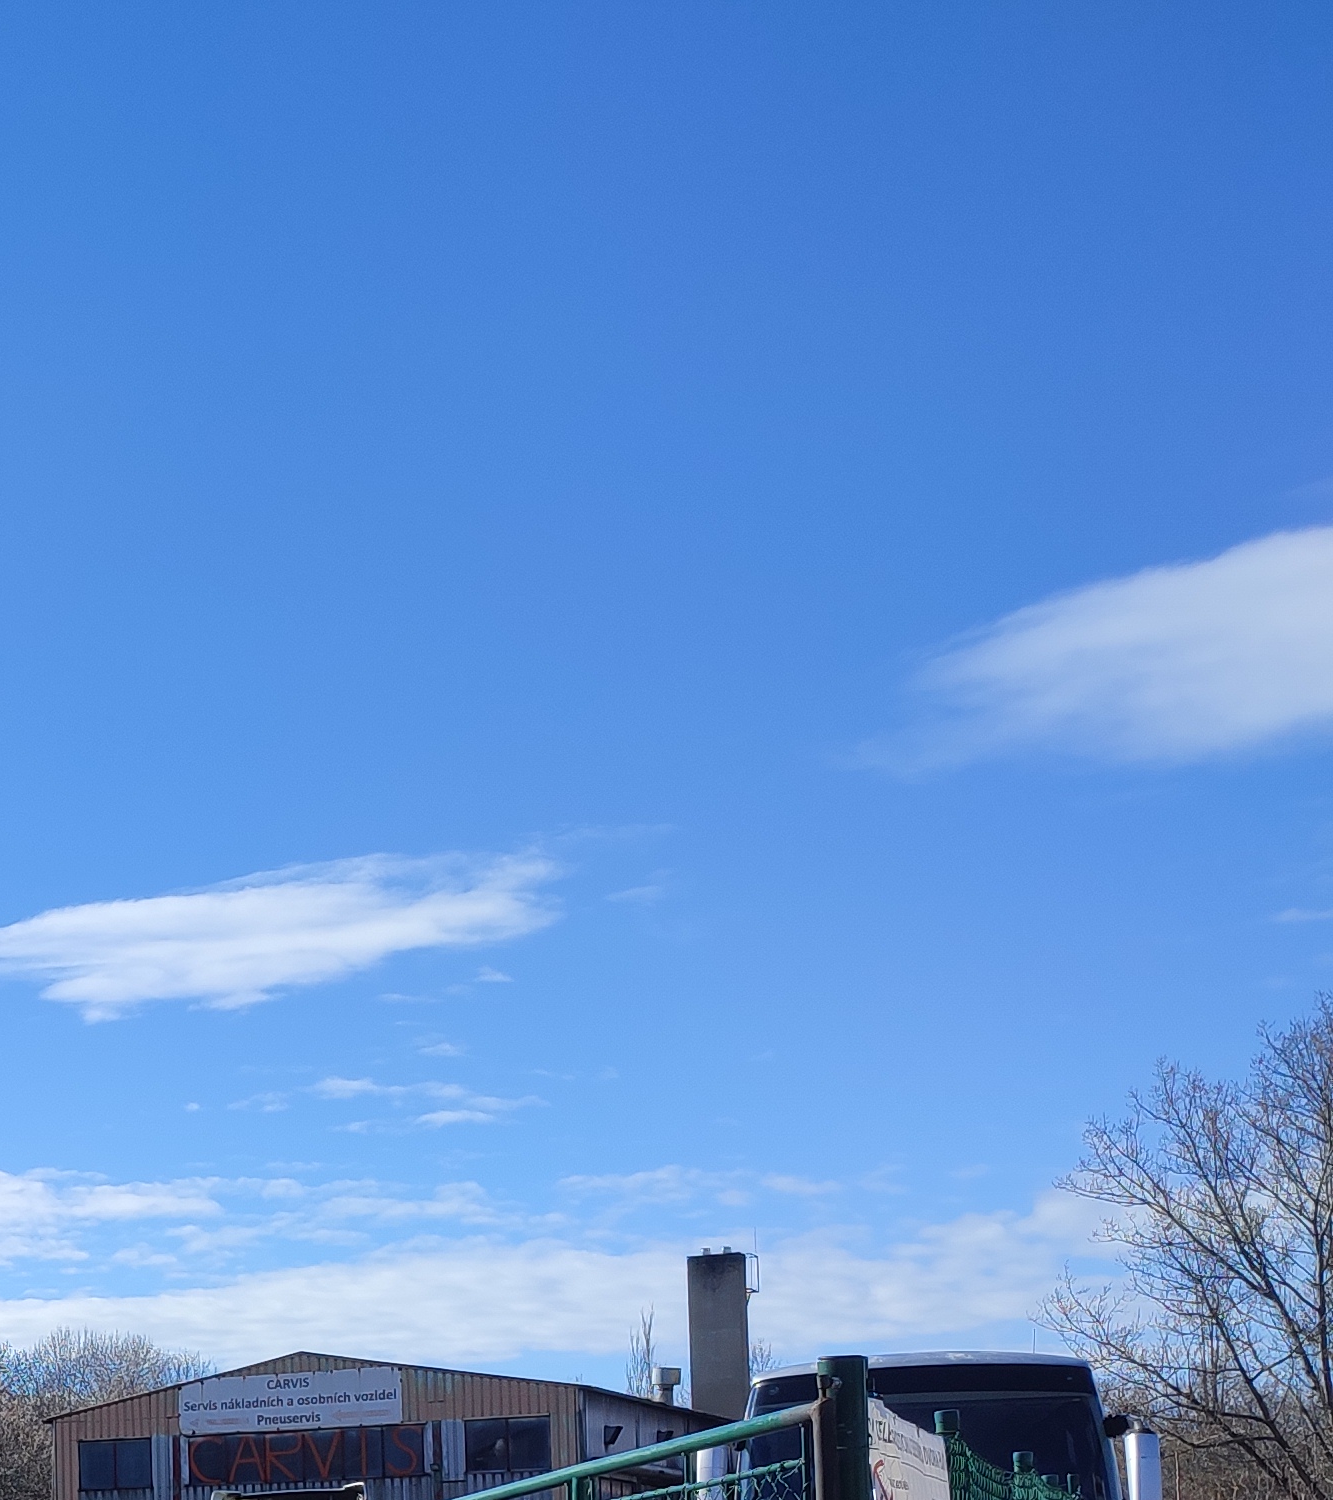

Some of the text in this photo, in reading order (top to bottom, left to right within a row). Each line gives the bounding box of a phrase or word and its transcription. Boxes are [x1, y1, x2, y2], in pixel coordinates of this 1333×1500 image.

[266, 1377, 310, 1390] CARVIS
[183, 1388, 397, 1412] Servis nákladních a osobních vozidel
[256, 1411, 321, 1426] Pneuservis
[190, 1425, 424, 1484] CARVIS
